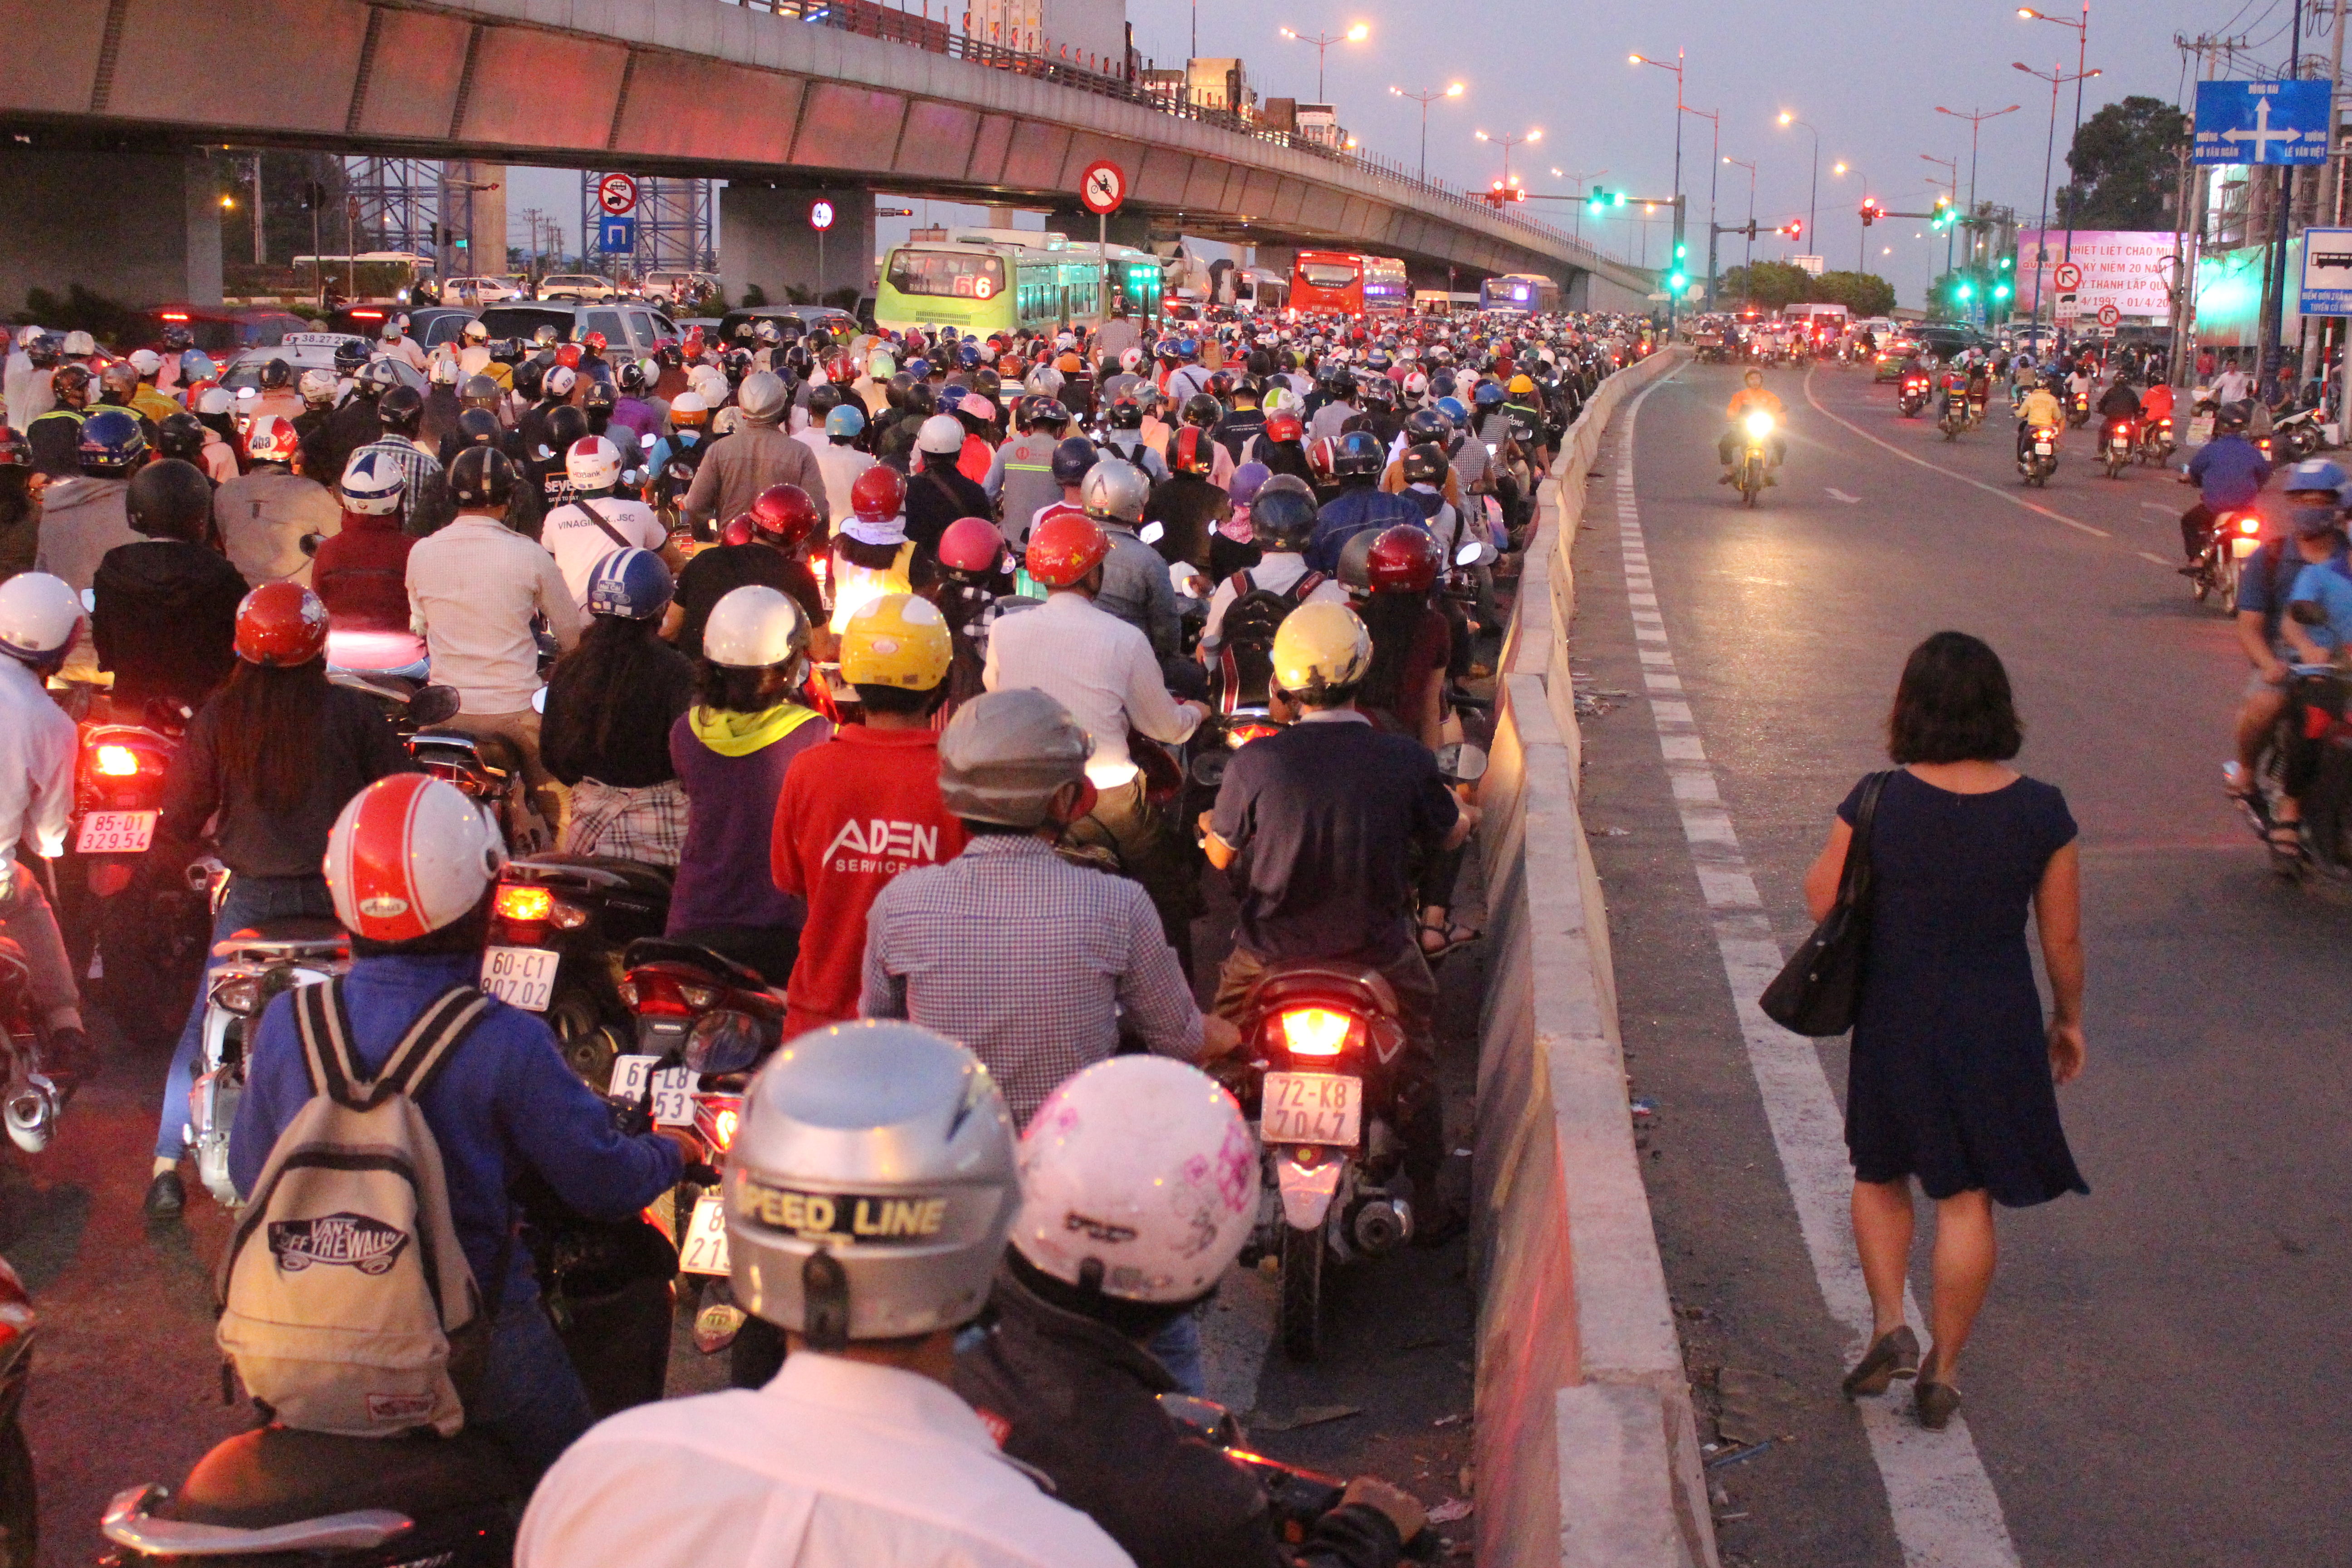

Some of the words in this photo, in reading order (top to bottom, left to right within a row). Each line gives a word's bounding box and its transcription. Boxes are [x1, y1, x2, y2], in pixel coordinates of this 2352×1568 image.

[816, 210, 821, 220] 4
[2101, 242, 2122, 258] LIỆT
[2126, 245, 2152, 256] CHÀO
[2083, 259, 2096, 272] KỶ
[2100, 261, 2125, 274] NIỆM
[2129, 264, 2141, 273] 20
[2091, 278, 2123, 289] THÀNH
[2127, 278, 2146, 292] LẬP
[2081, 297, 2117, 307] 4/1997
[2127, 298, 2168, 308] 01/4/20
[302, 335, 332, 343] 38.27
[252, 435, 270, 450] Aba
[573, 470, 601, 478] HDBank
[544, 480, 577, 493] SEVE
[95, 815, 145, 831] 85-D1
[83, 833, 146, 849] 329.54
[822, 818, 938, 869] ADEN
[835, 859, 916, 874] SERVICE
[493, 952, 545, 979] 60-C1
[1278, 1078, 1347, 1109] 72-K8
[1276, 1109, 1346, 1140] 7047
[853, 1198, 947, 1235] LINE
[310, 1219, 355, 1239] VANS
[311, 1235, 348, 1258] THE
